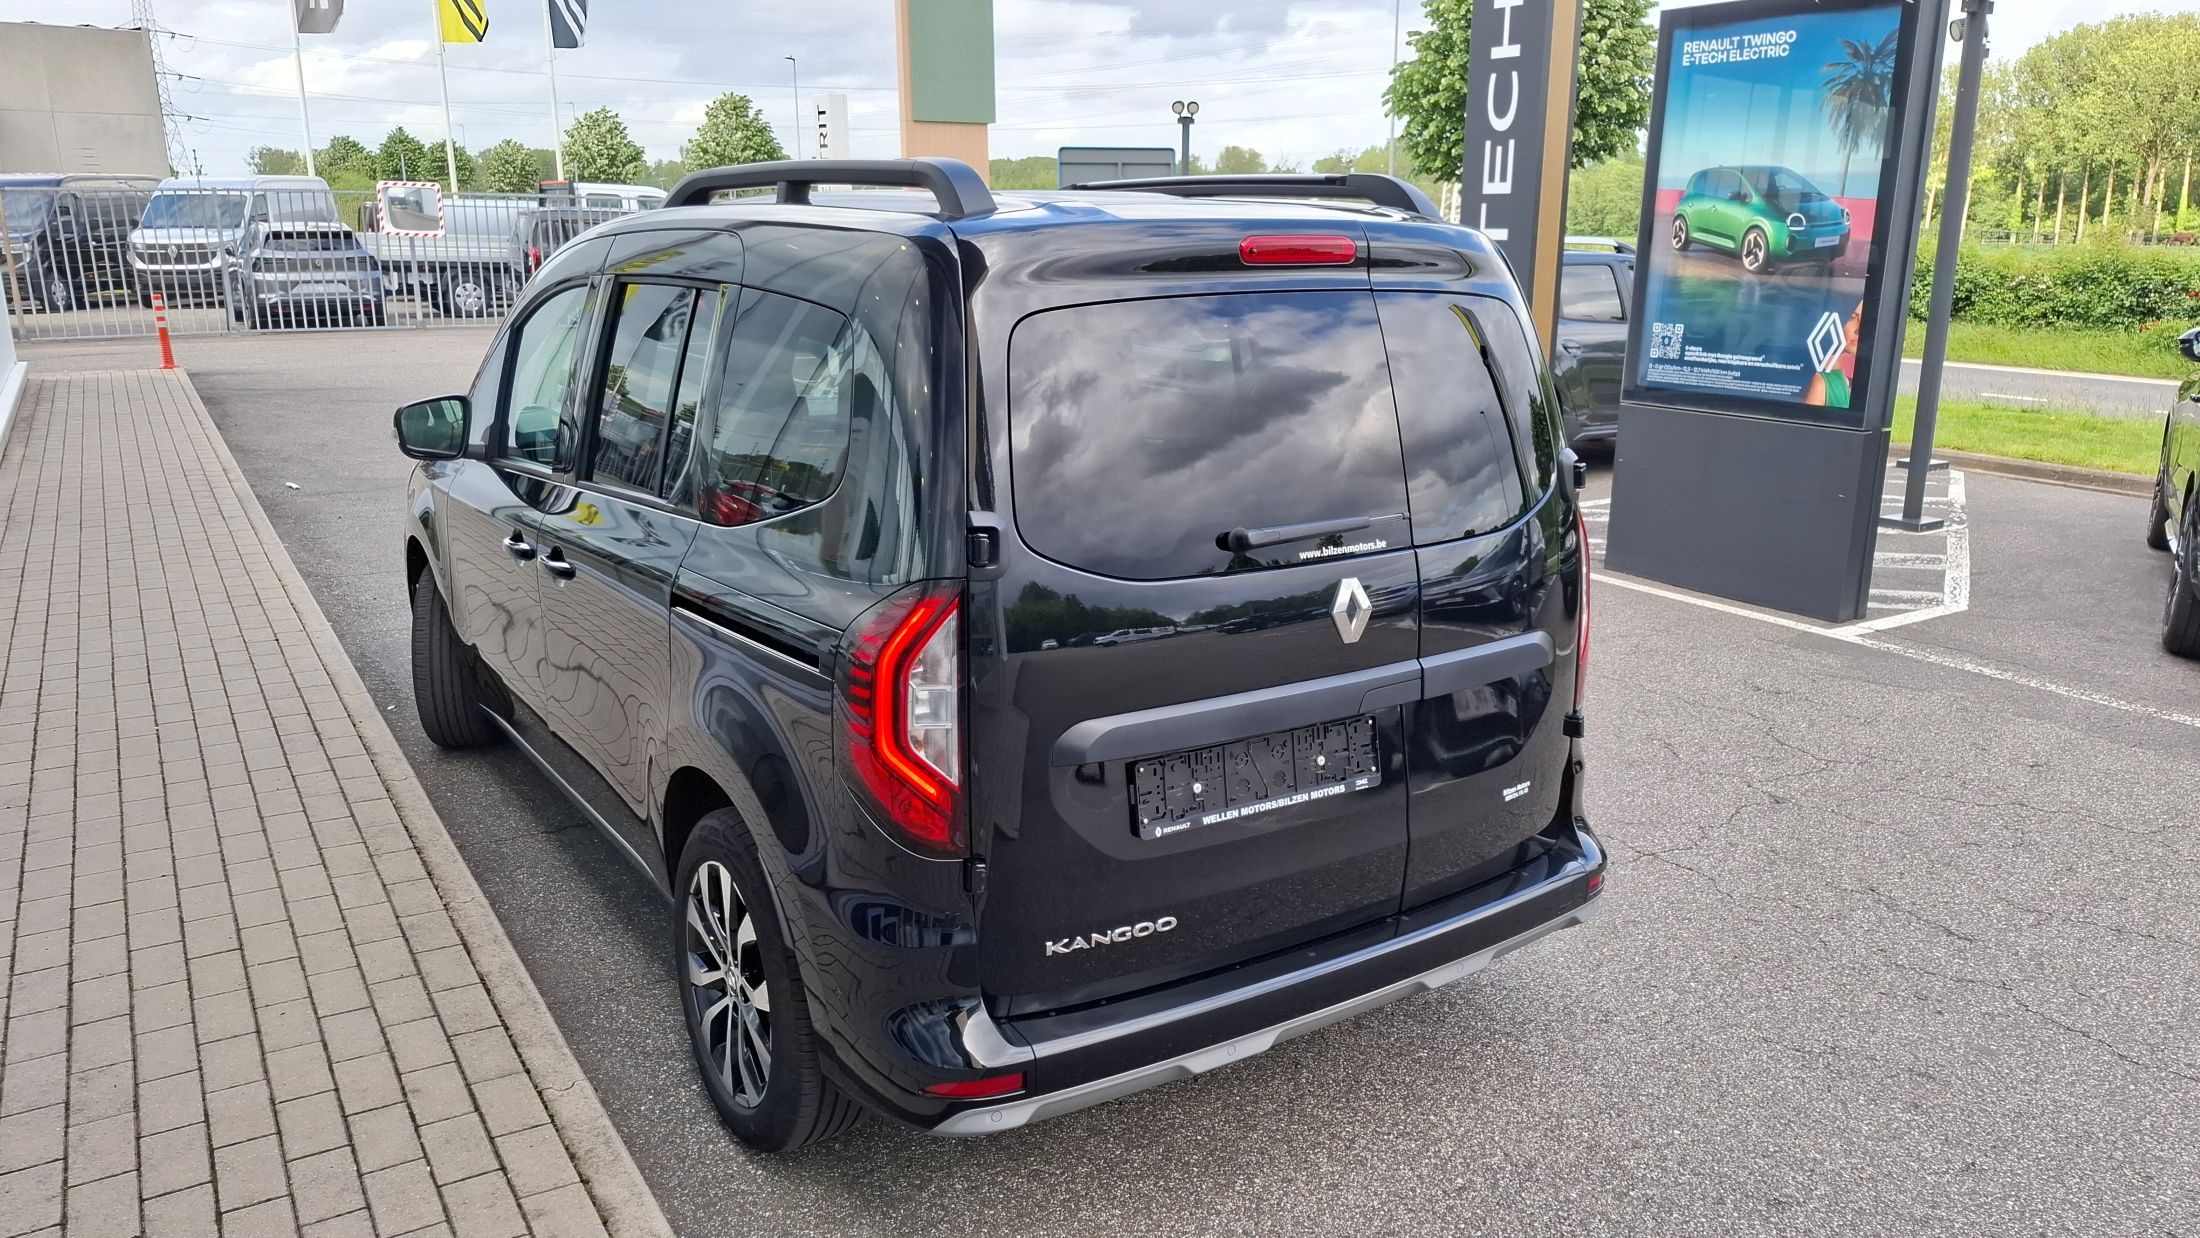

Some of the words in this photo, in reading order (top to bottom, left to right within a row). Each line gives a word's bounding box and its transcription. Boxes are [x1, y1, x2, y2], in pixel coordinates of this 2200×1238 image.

[1684, 36, 1740, 53] RENAULT
[1742, 30, 1797, 47] TWINGO
[1682, 50, 1727, 66] E-TECH
[1729, 44, 1790, 62] ELECTRIC
[1480, 0, 1524, 241] TECH
[1299, 539, 1387, 560] www.bilzenmotors.be
[1202, 809, 1239, 825] WELLEN
[1241, 792, 1309, 816] MOTORS/BILZEN
[1310, 784, 1346, 800] MOTORS
[1163, 822, 1191, 834] RENAULT
[1045, 916, 1178, 957] KANGOO
